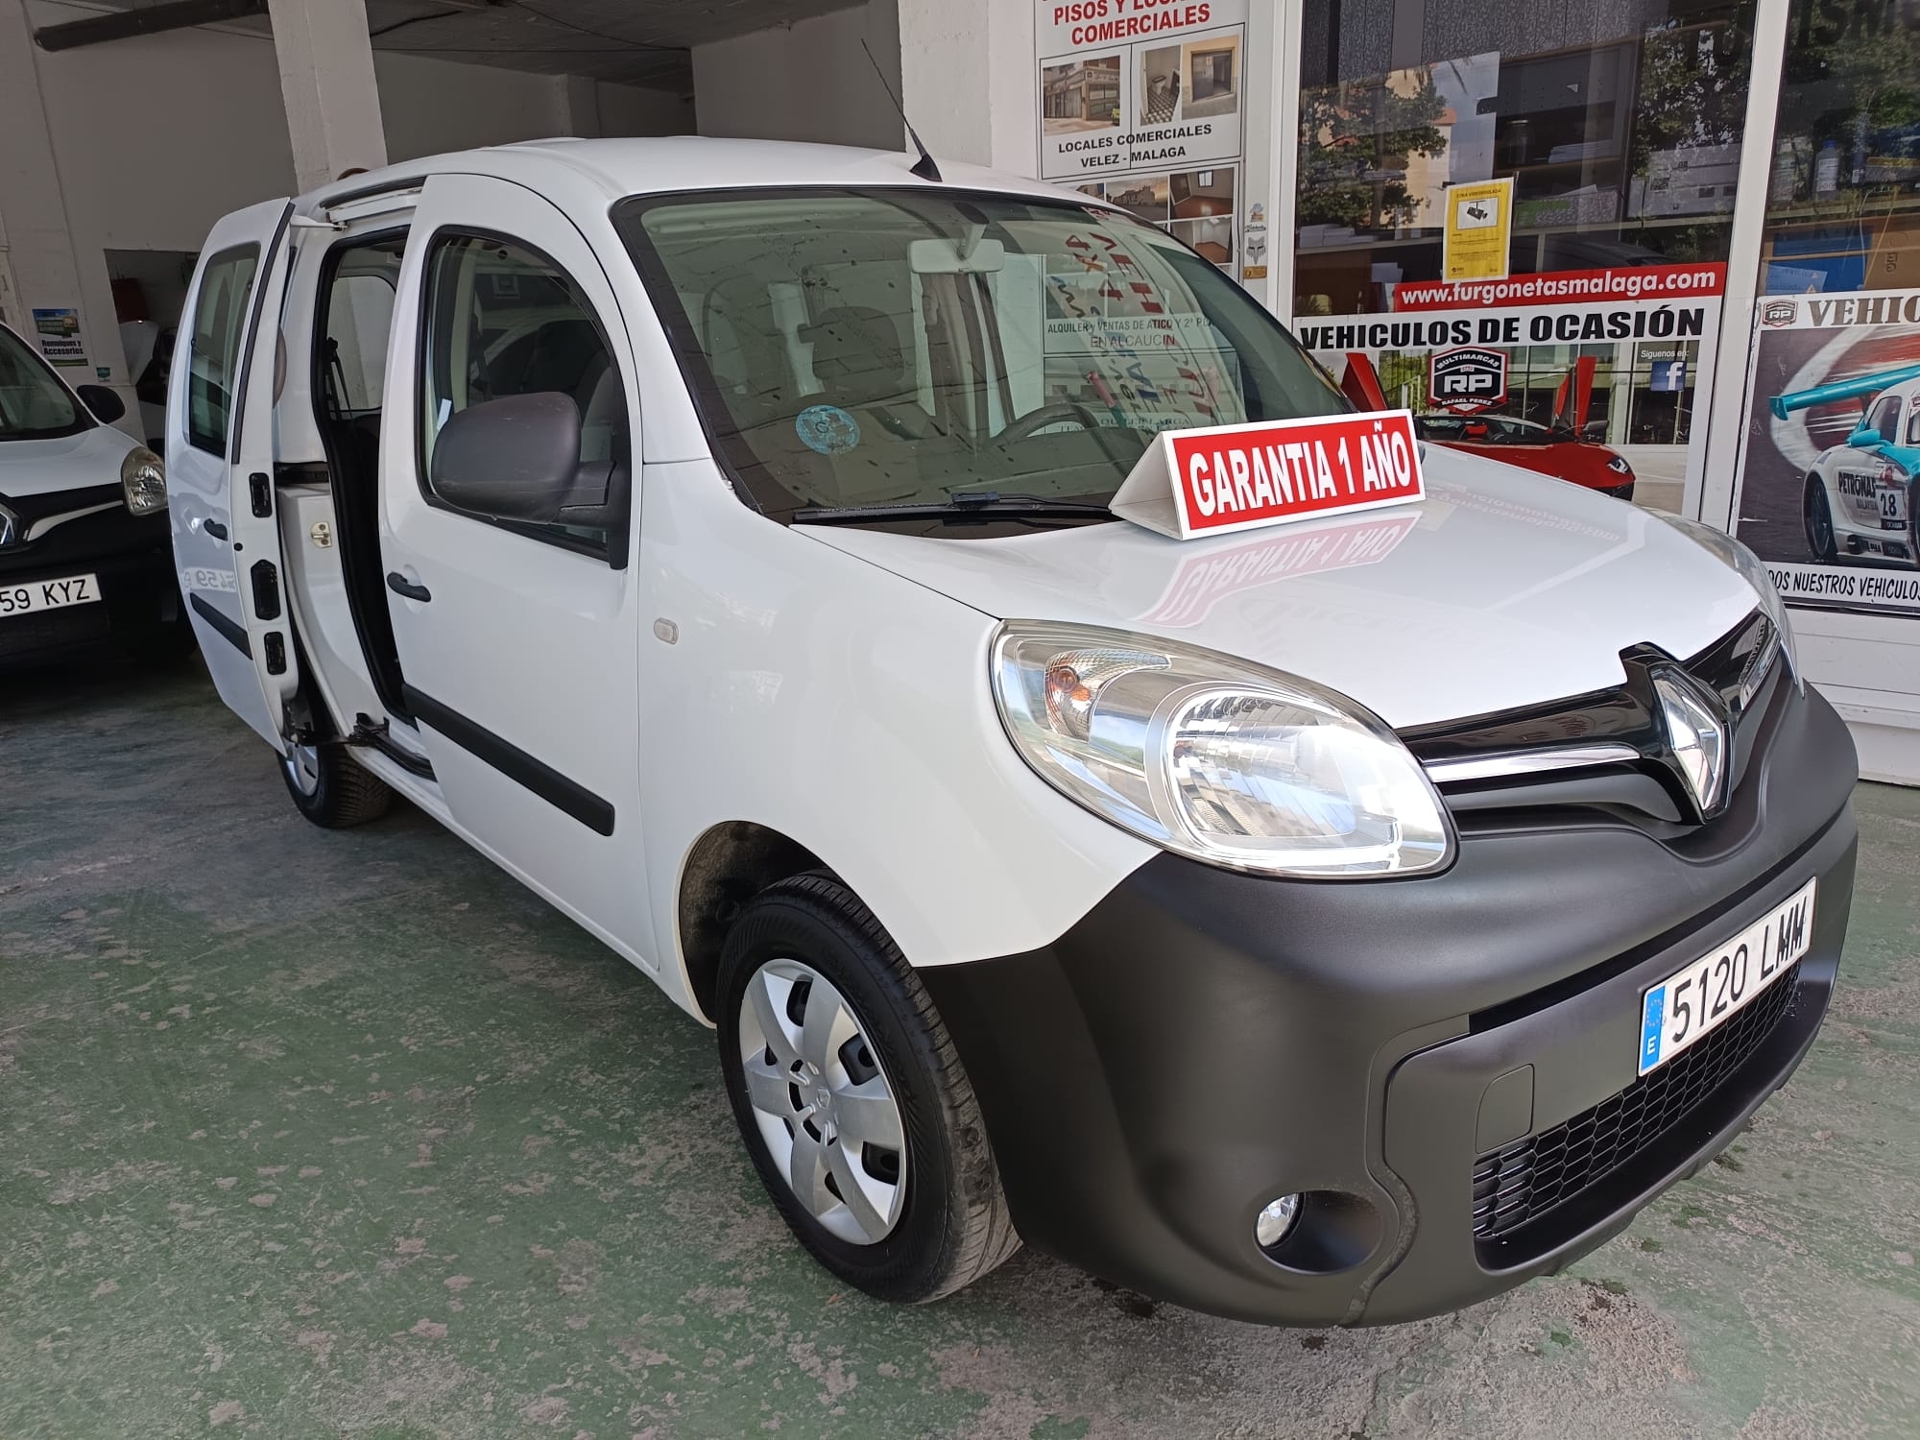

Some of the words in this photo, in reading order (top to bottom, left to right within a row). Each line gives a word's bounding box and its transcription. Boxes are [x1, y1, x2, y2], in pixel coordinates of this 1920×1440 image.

[1054, 0, 1108, 25] PISOS
[1071, 3, 1210, 45] COMERCIALES
[1058, 136, 1113, 153] LOCALES
[1117, 124, 1212, 146] COMERCIALES
[1081, 154, 1119, 168] VELEZ
[1131, 146, 1186, 162] MALAGA
[1402, 270, 1716, 304] www.furgonetasmalaga.com
[1047, 322, 1089, 334] ALQUILER
[1097, 320, 1130, 332] VENTAS
[1132, 321, 1145, 331] DE
[1300, 320, 1472, 350] VEHICULOS
[1478, 317, 1520, 343] DE
[1530, 304, 1705, 342] OCASIÓN
[1769, 311, 1791, 319] RP
[1436, 354, 1500, 369] MULTIMARCAS
[1443, 374, 1493, 393] RP
[1442, 398, 1467, 406] RAFAEL
[1189, 440, 1338, 517] GARANTIA
[1338, 436, 1356, 494] 1
[1360, 420, 1411, 491] AÑO
[1880, 492, 1897, 517] 28
[42, 579, 90, 606] KYZ
[1793, 571, 1856, 596] NUESTROS
[1860, 576, 1920, 600] VEHICULO
[1672, 943, 1748, 1044] 5120
[1760, 896, 1807, 982] LMM
[1646, 1035, 1657, 1056] E
